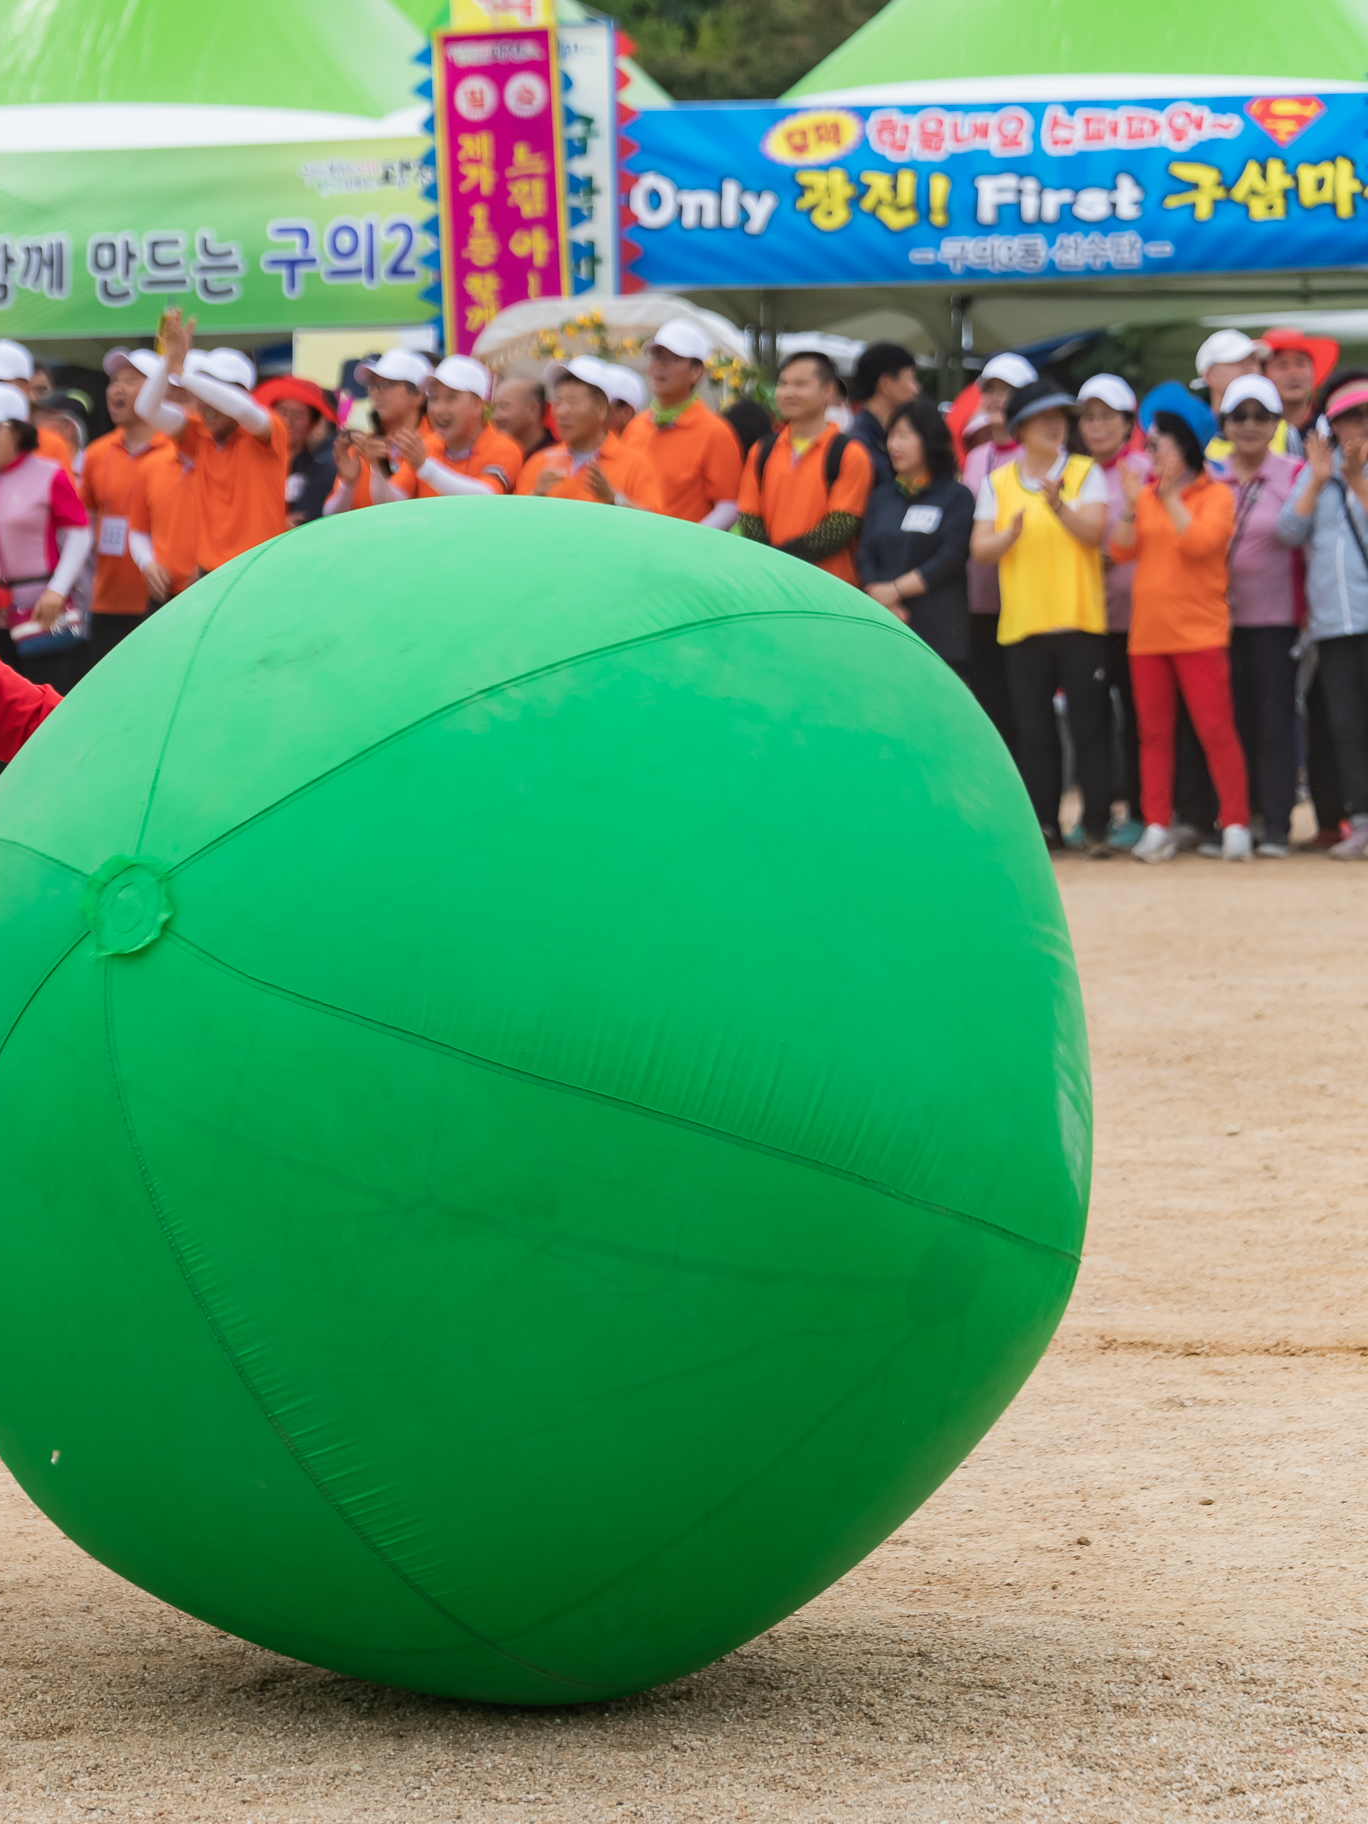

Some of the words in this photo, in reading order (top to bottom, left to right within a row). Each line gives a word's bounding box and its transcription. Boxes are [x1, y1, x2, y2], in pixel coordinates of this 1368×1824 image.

[630, 170, 778, 236] Only
[794, 167, 952, 232] 광진!
[974, 171, 1144, 225] First
[1162, 155, 1368, 222] 구삼마
[93, 234, 240, 300] 만드는
[265, 221, 417, 292] 구의2
